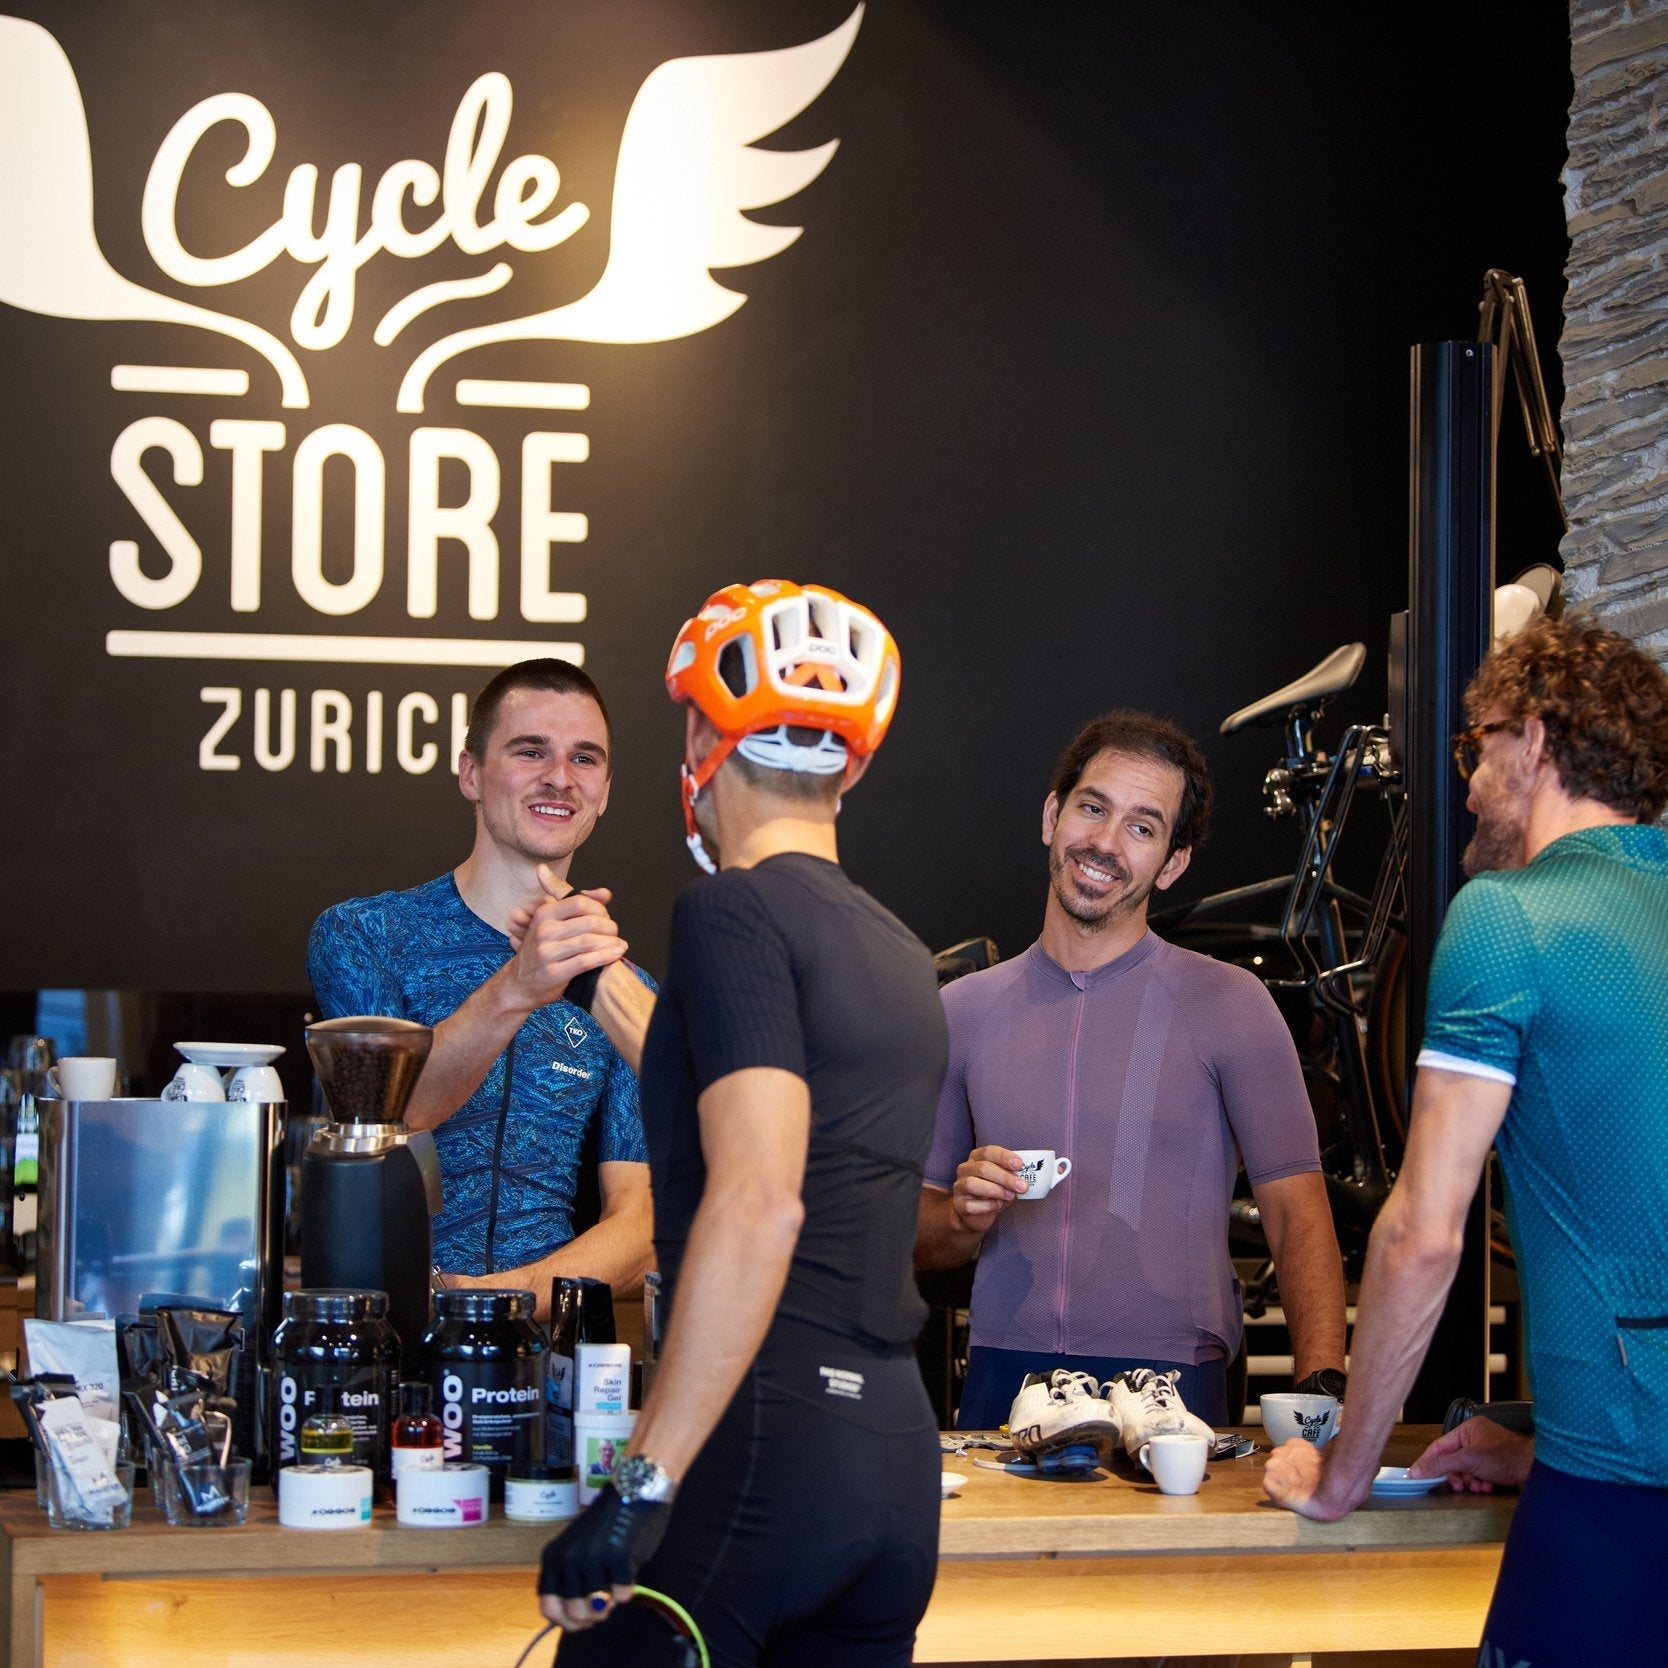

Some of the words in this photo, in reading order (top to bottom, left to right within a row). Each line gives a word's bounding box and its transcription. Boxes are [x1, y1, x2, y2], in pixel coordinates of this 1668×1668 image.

[142, 72, 590, 350] Cycle
[109, 417, 590, 623] STORE
[552, 1061, 591, 1079] Disorder
[304, 1390, 379, 1407] Ptein
[471, 1386, 540, 1404] Protein
[1302, 1428, 1320, 1438] CAFE
